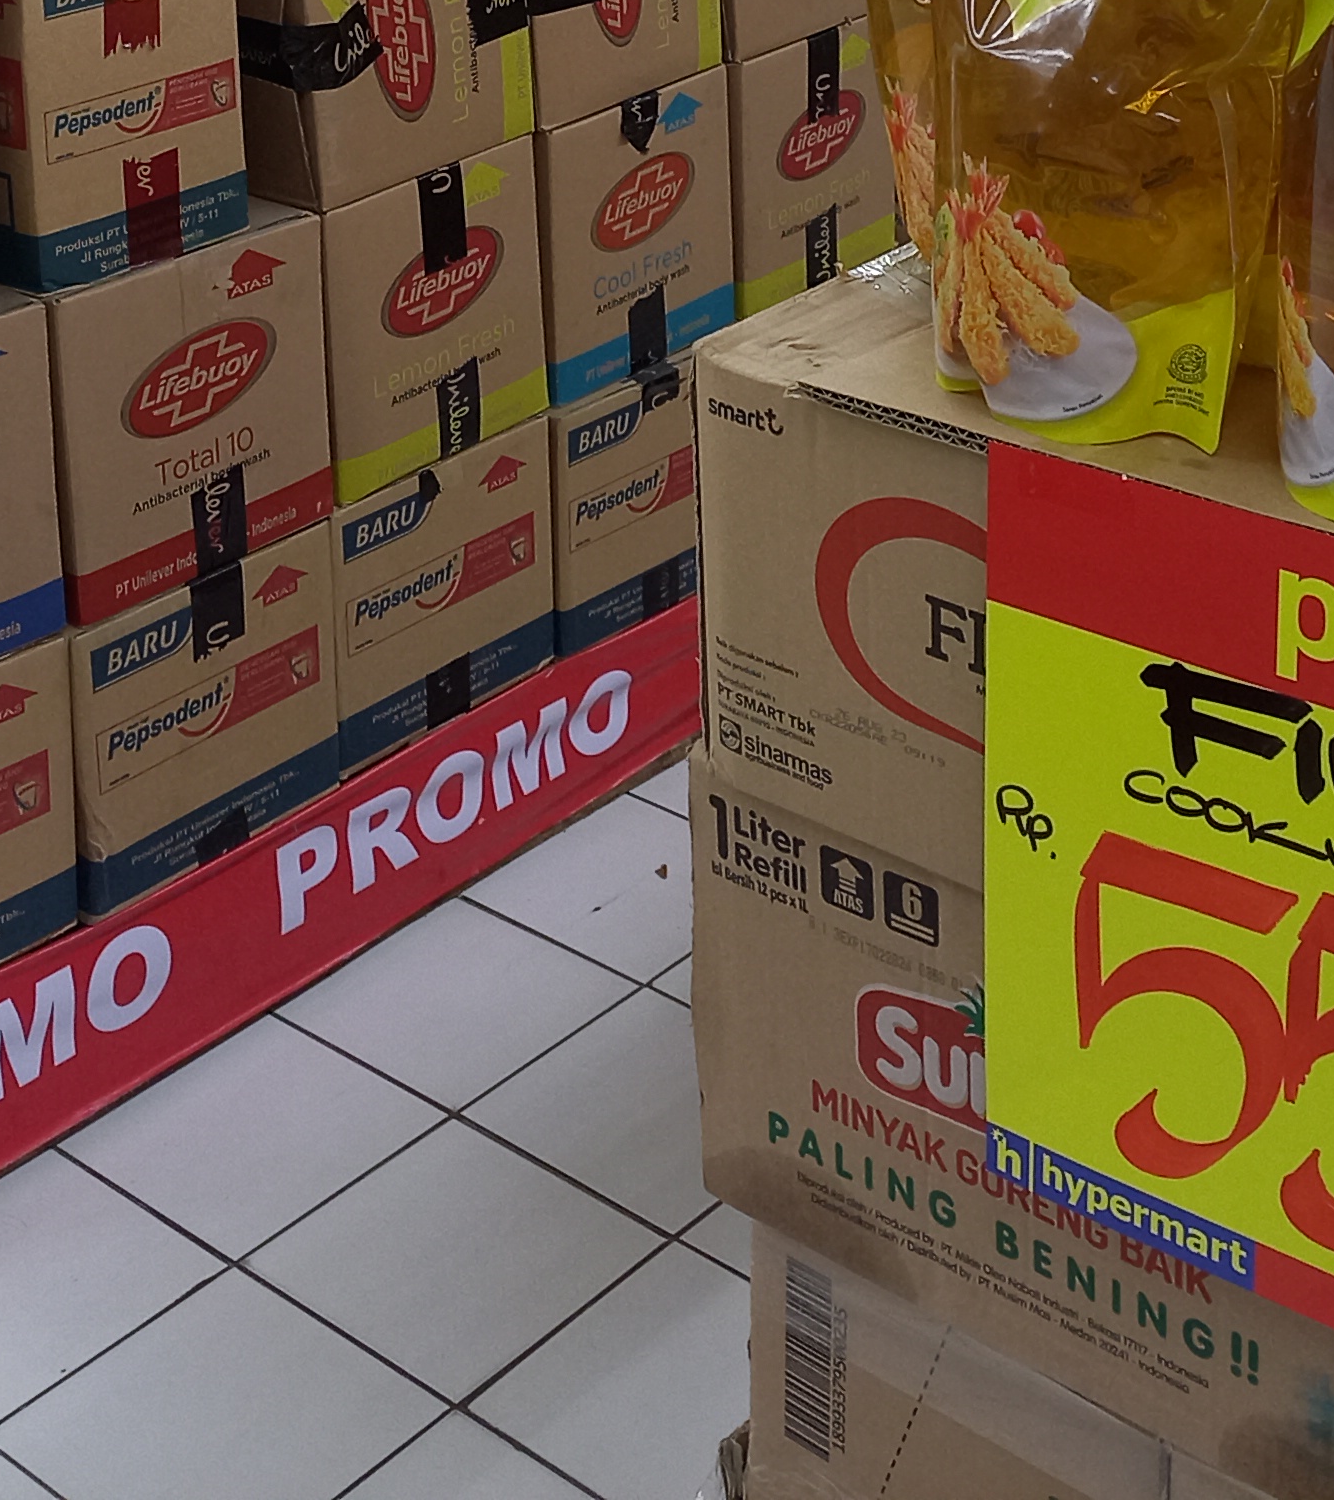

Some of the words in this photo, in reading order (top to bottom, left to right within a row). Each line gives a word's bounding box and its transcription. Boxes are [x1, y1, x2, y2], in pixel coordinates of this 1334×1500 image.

[53, 91, 156, 137] Pepsodent
[604, 173, 684, 225] Lifebuoy
[396, 249, 490, 305] Lifebuoy
[593, 257, 638, 298] Cool
[641, 238, 693, 279] Fresh
[142, 346, 259, 411] Lifebuoy
[155, 435, 223, 486] Total
[228, 425, 255, 457] 10
[354, 560, 457, 626] Pepsodent
[106, 681, 225, 759] Pepsodent
[743, 735, 834, 786] sinarmas
[276, 668, 633, 936] PROMO
[733, 804, 806, 860] Liter
[733, 841, 808, 895] Refill
[810, 1078, 948, 1175] MINYAK
[767, 1109, 957, 1230] PALING
[1042, 1151, 1249, 1278] hypermart
